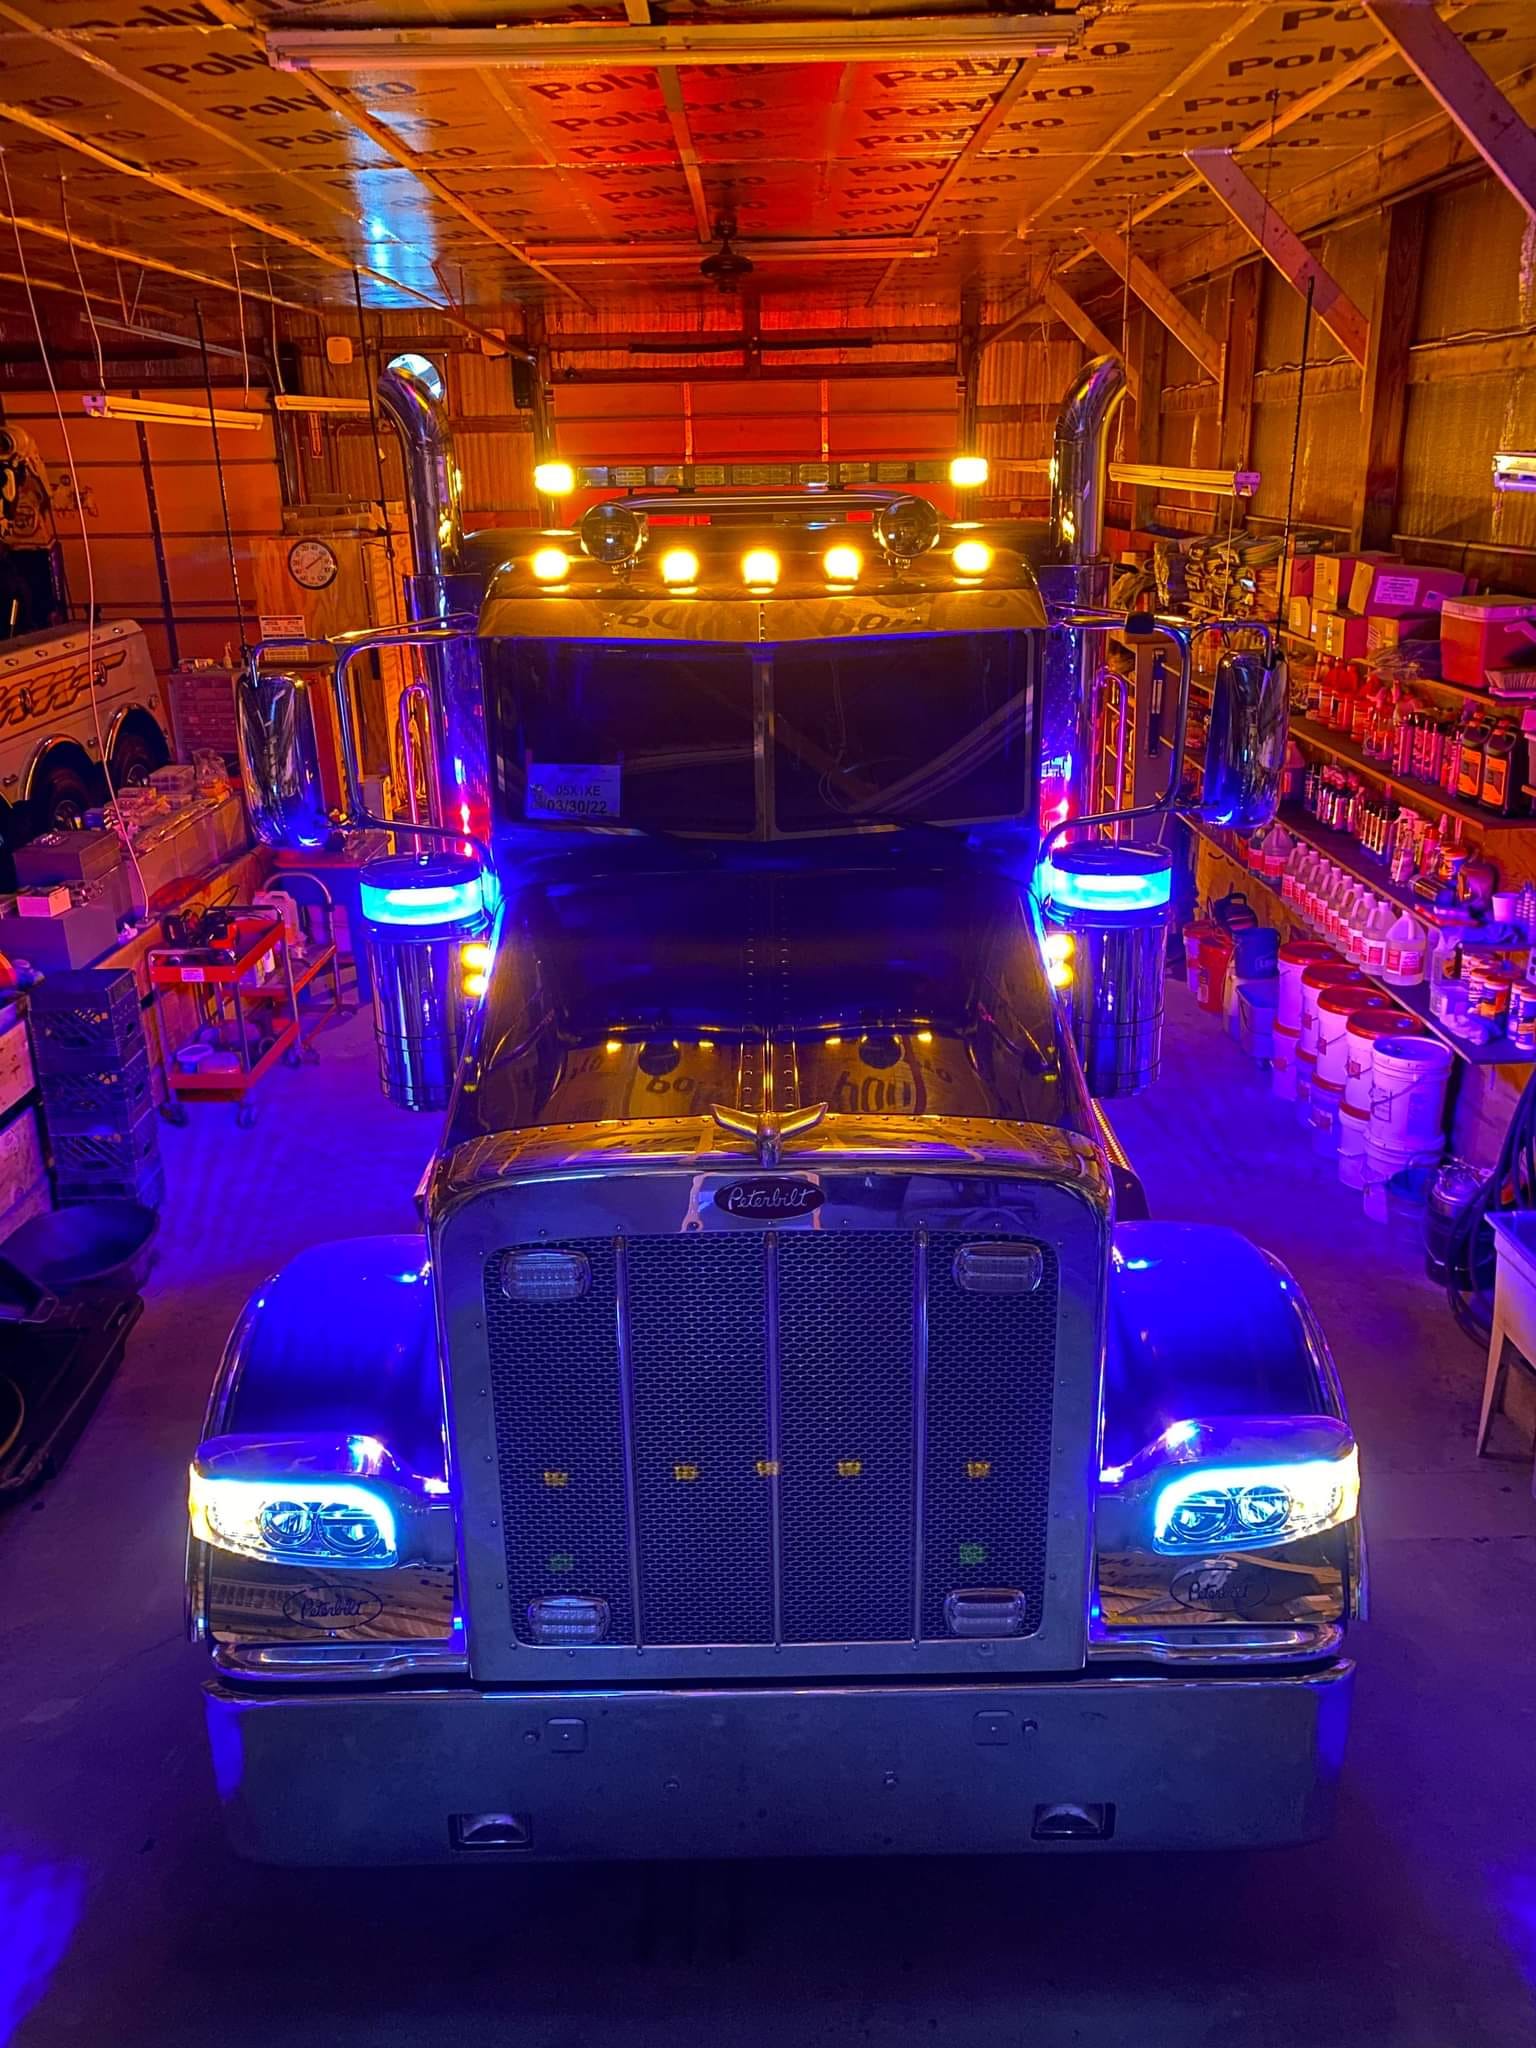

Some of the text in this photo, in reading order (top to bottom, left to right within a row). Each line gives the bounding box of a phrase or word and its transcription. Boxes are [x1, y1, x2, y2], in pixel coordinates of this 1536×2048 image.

[547, 799, 608, 814] 03/30/22
[728, 1187, 816, 1210] Peterbilt
[300, 1597, 369, 1620] Peterbilt
